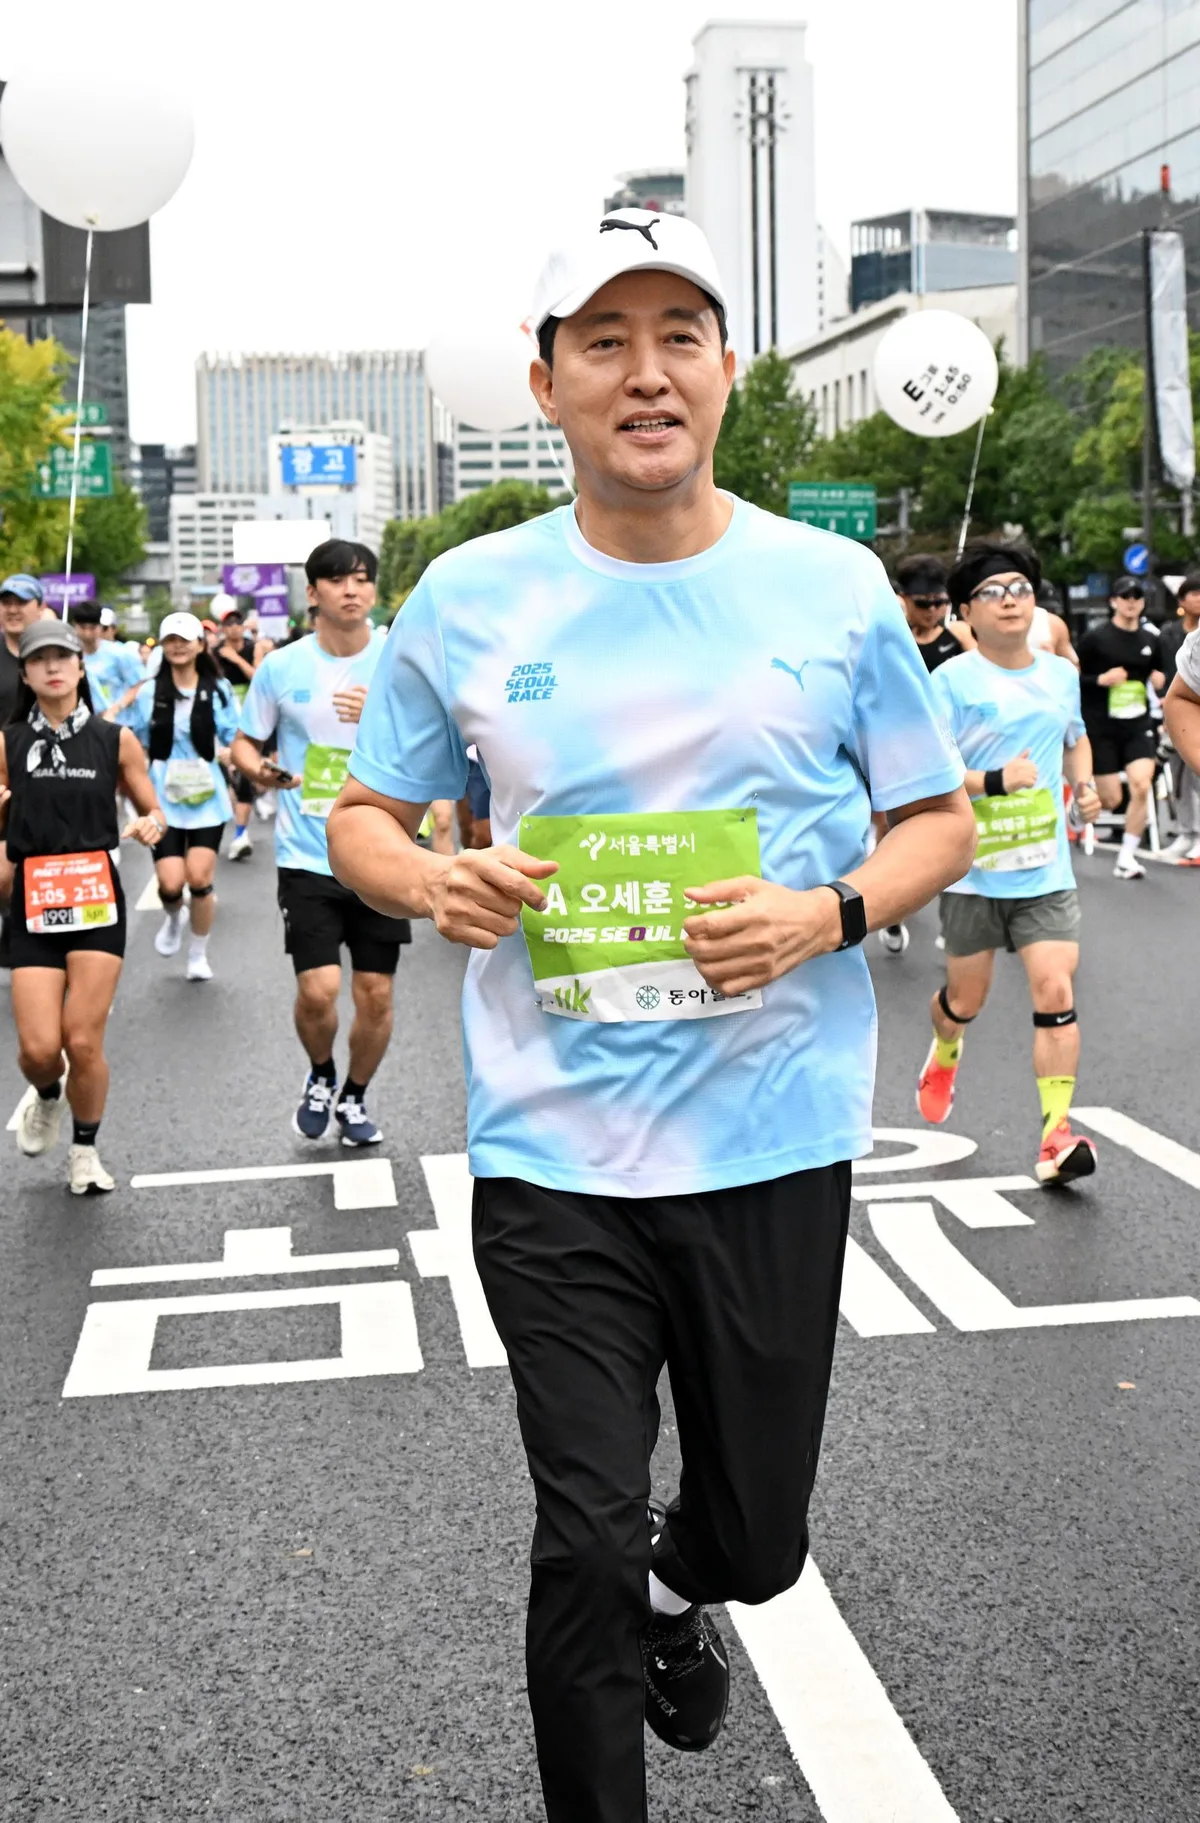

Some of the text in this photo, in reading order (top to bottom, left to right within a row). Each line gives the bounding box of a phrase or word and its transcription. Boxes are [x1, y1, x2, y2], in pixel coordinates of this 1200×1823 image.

[903, 380, 924, 402] E
[511, 662, 553, 677] 2025
[504, 675, 558, 691] SEOUL
[508, 687, 554, 703] RACE
[32, 768, 97, 779] SALMON
[608, 832, 696, 856] 서울특별시
[30, 887, 66, 906] 1:05
[74, 883, 109, 903] 2:15
[543, 883, 568, 916] A
[579, 881, 673, 915] 오세훈
[543, 927, 597, 943] 2025
[598, 926, 676, 944] SEOUL
[667, 988, 747, 1006] 동아일
